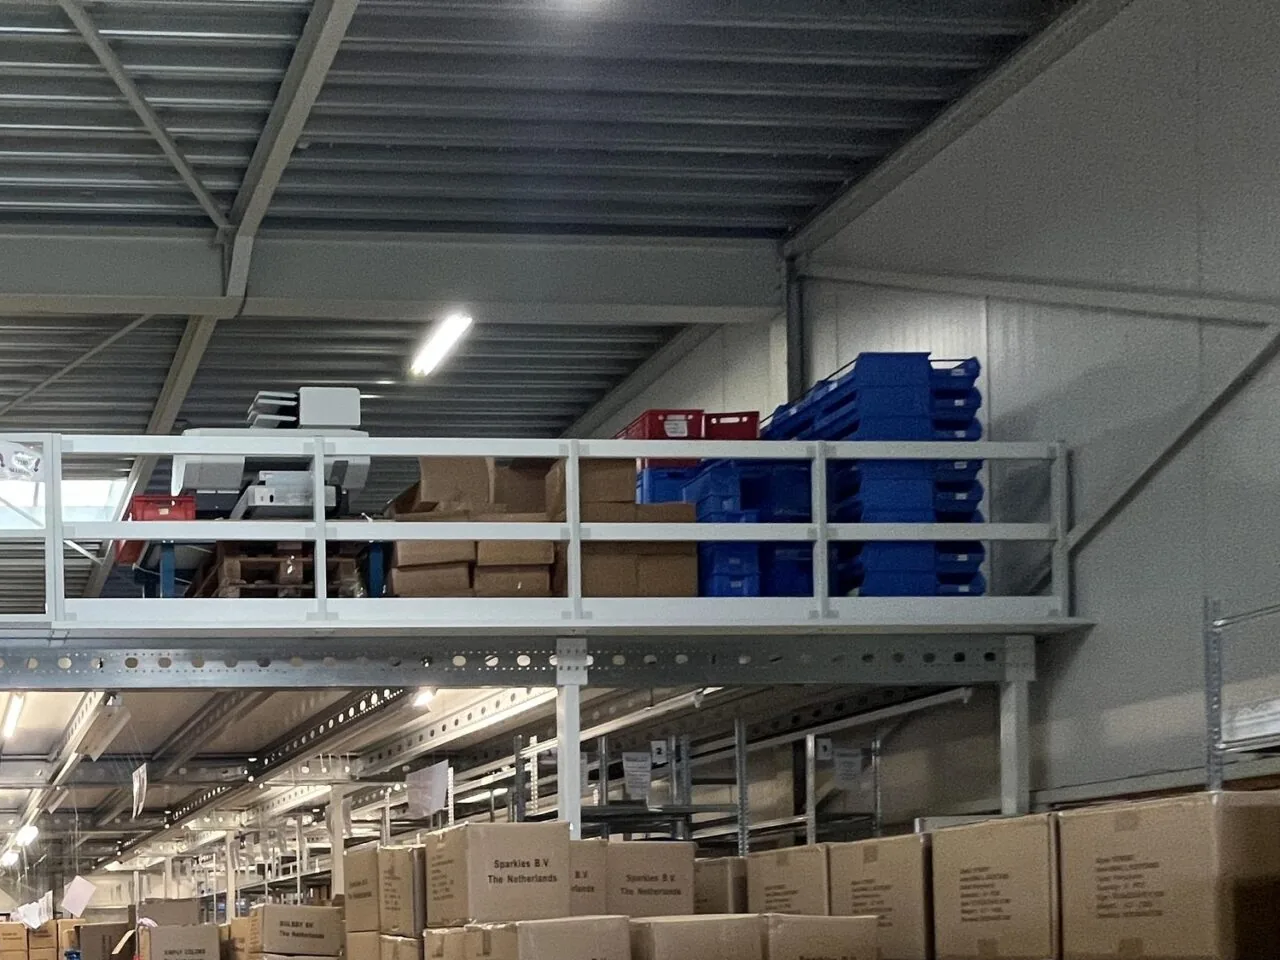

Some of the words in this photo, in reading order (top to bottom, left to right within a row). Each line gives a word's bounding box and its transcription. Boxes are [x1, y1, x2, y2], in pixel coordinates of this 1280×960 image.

[494, 859, 530, 869] Sparkles
[488, 875, 503, 884] The
[507, 874, 557, 883] Netherlands
